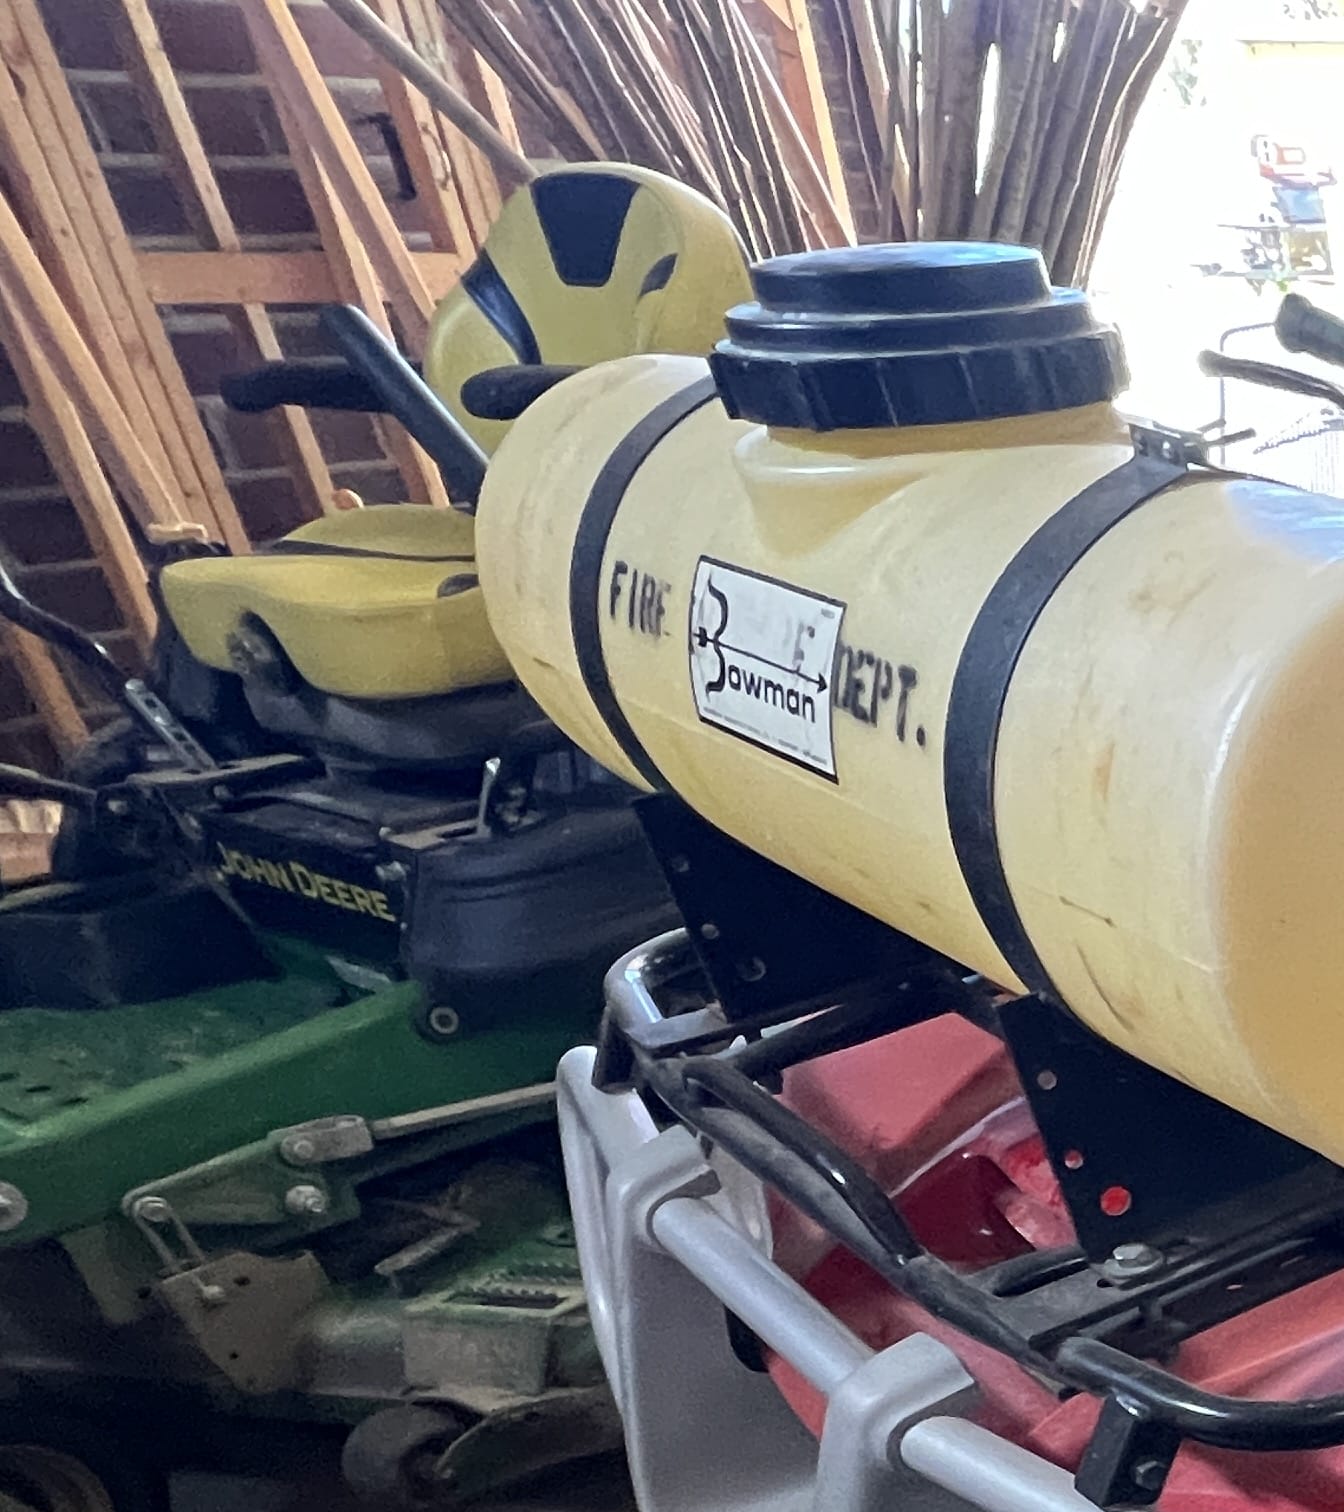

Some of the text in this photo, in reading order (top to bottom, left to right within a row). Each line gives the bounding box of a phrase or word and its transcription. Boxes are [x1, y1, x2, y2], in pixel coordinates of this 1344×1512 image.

[609, 559, 673, 638] FIRE
[704, 568, 817, 724] Bowman
[216, 841, 397, 923] JOHN DEERE
